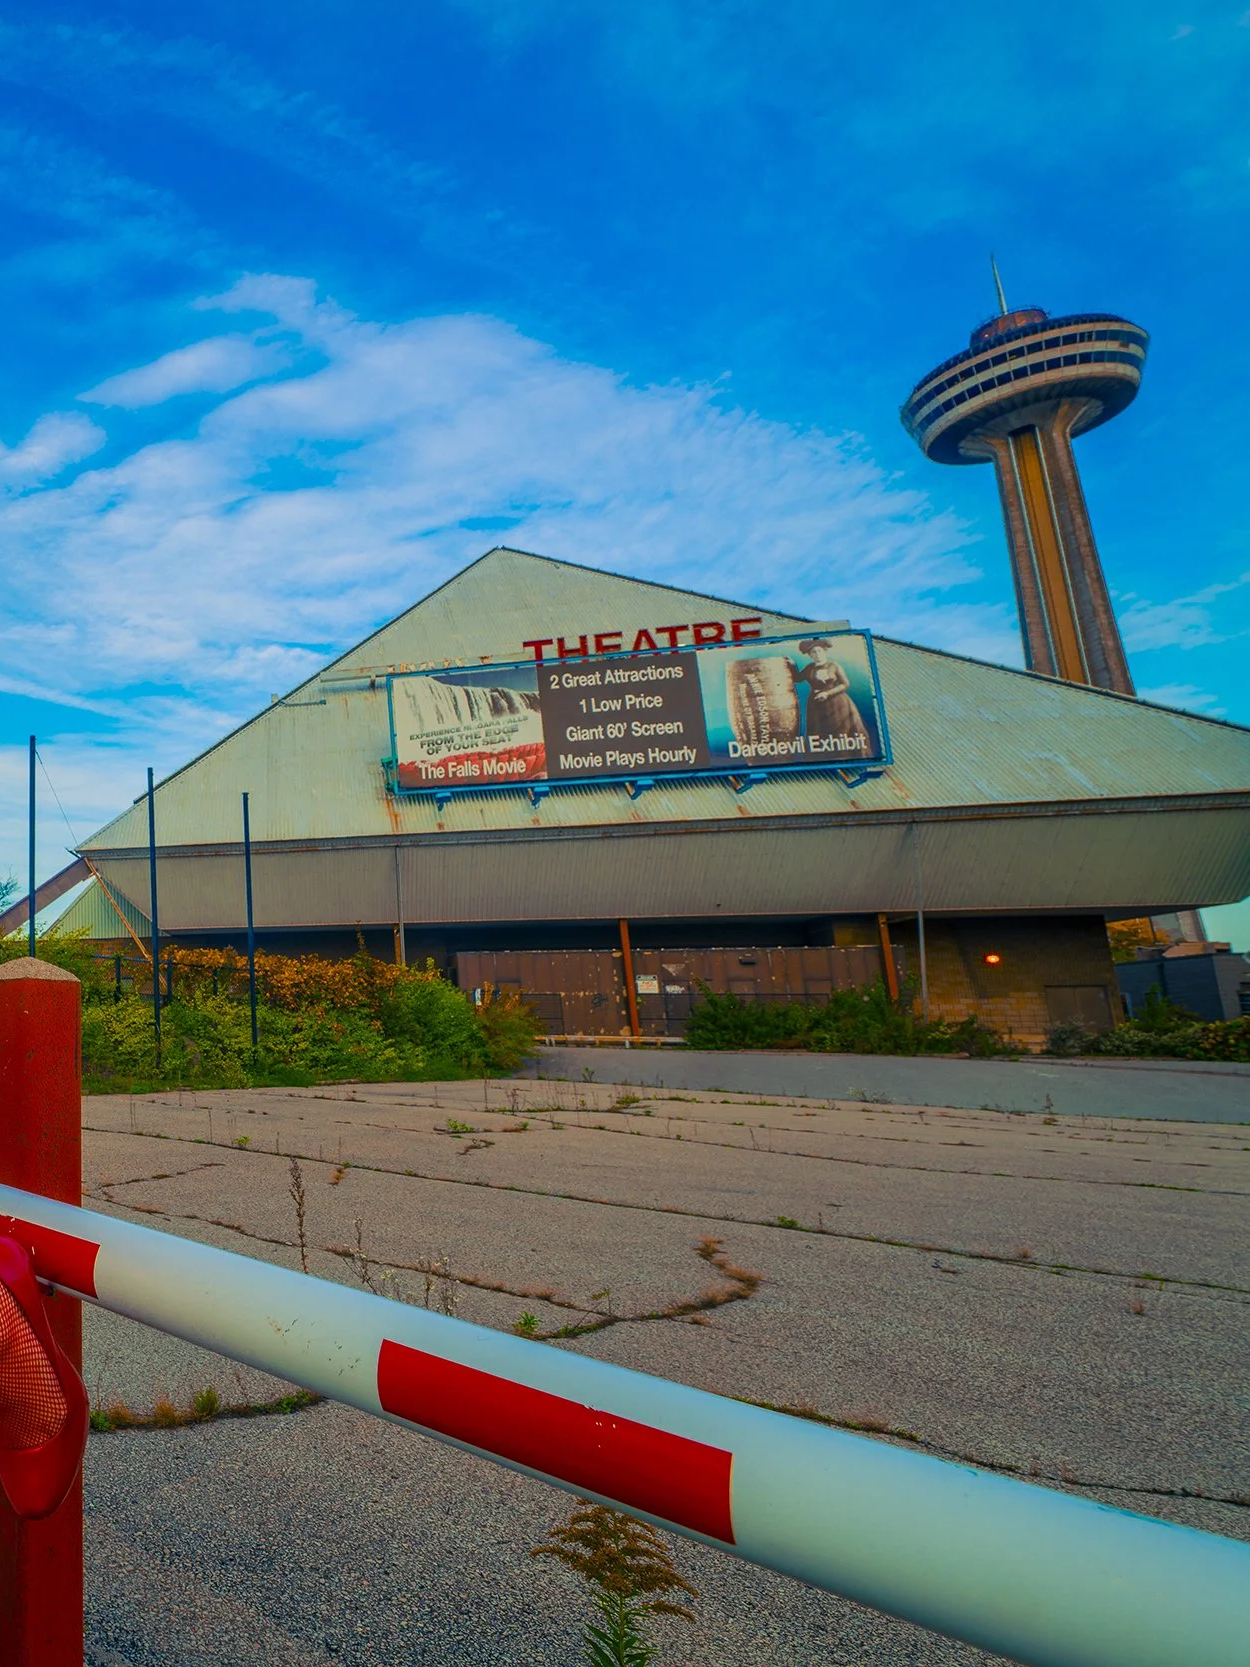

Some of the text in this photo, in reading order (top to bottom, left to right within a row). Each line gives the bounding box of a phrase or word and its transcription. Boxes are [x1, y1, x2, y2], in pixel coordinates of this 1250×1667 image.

[550, 665, 684, 690] 2 Great Attractions
[579, 693, 664, 713] 1 Low Price
[409, 727, 461, 741] EXPERIENCE
[420, 724, 519, 749] FROM THE EDGE
[566, 721, 684, 742] Giant 60' Screen
[426, 735, 513, 756] OF YOUR SEAT
[728, 732, 868, 758] Daredevil Exhibit
[419, 757, 527, 780] The Falls Movie
[559, 745, 697, 770] Movie Plays Hourly
